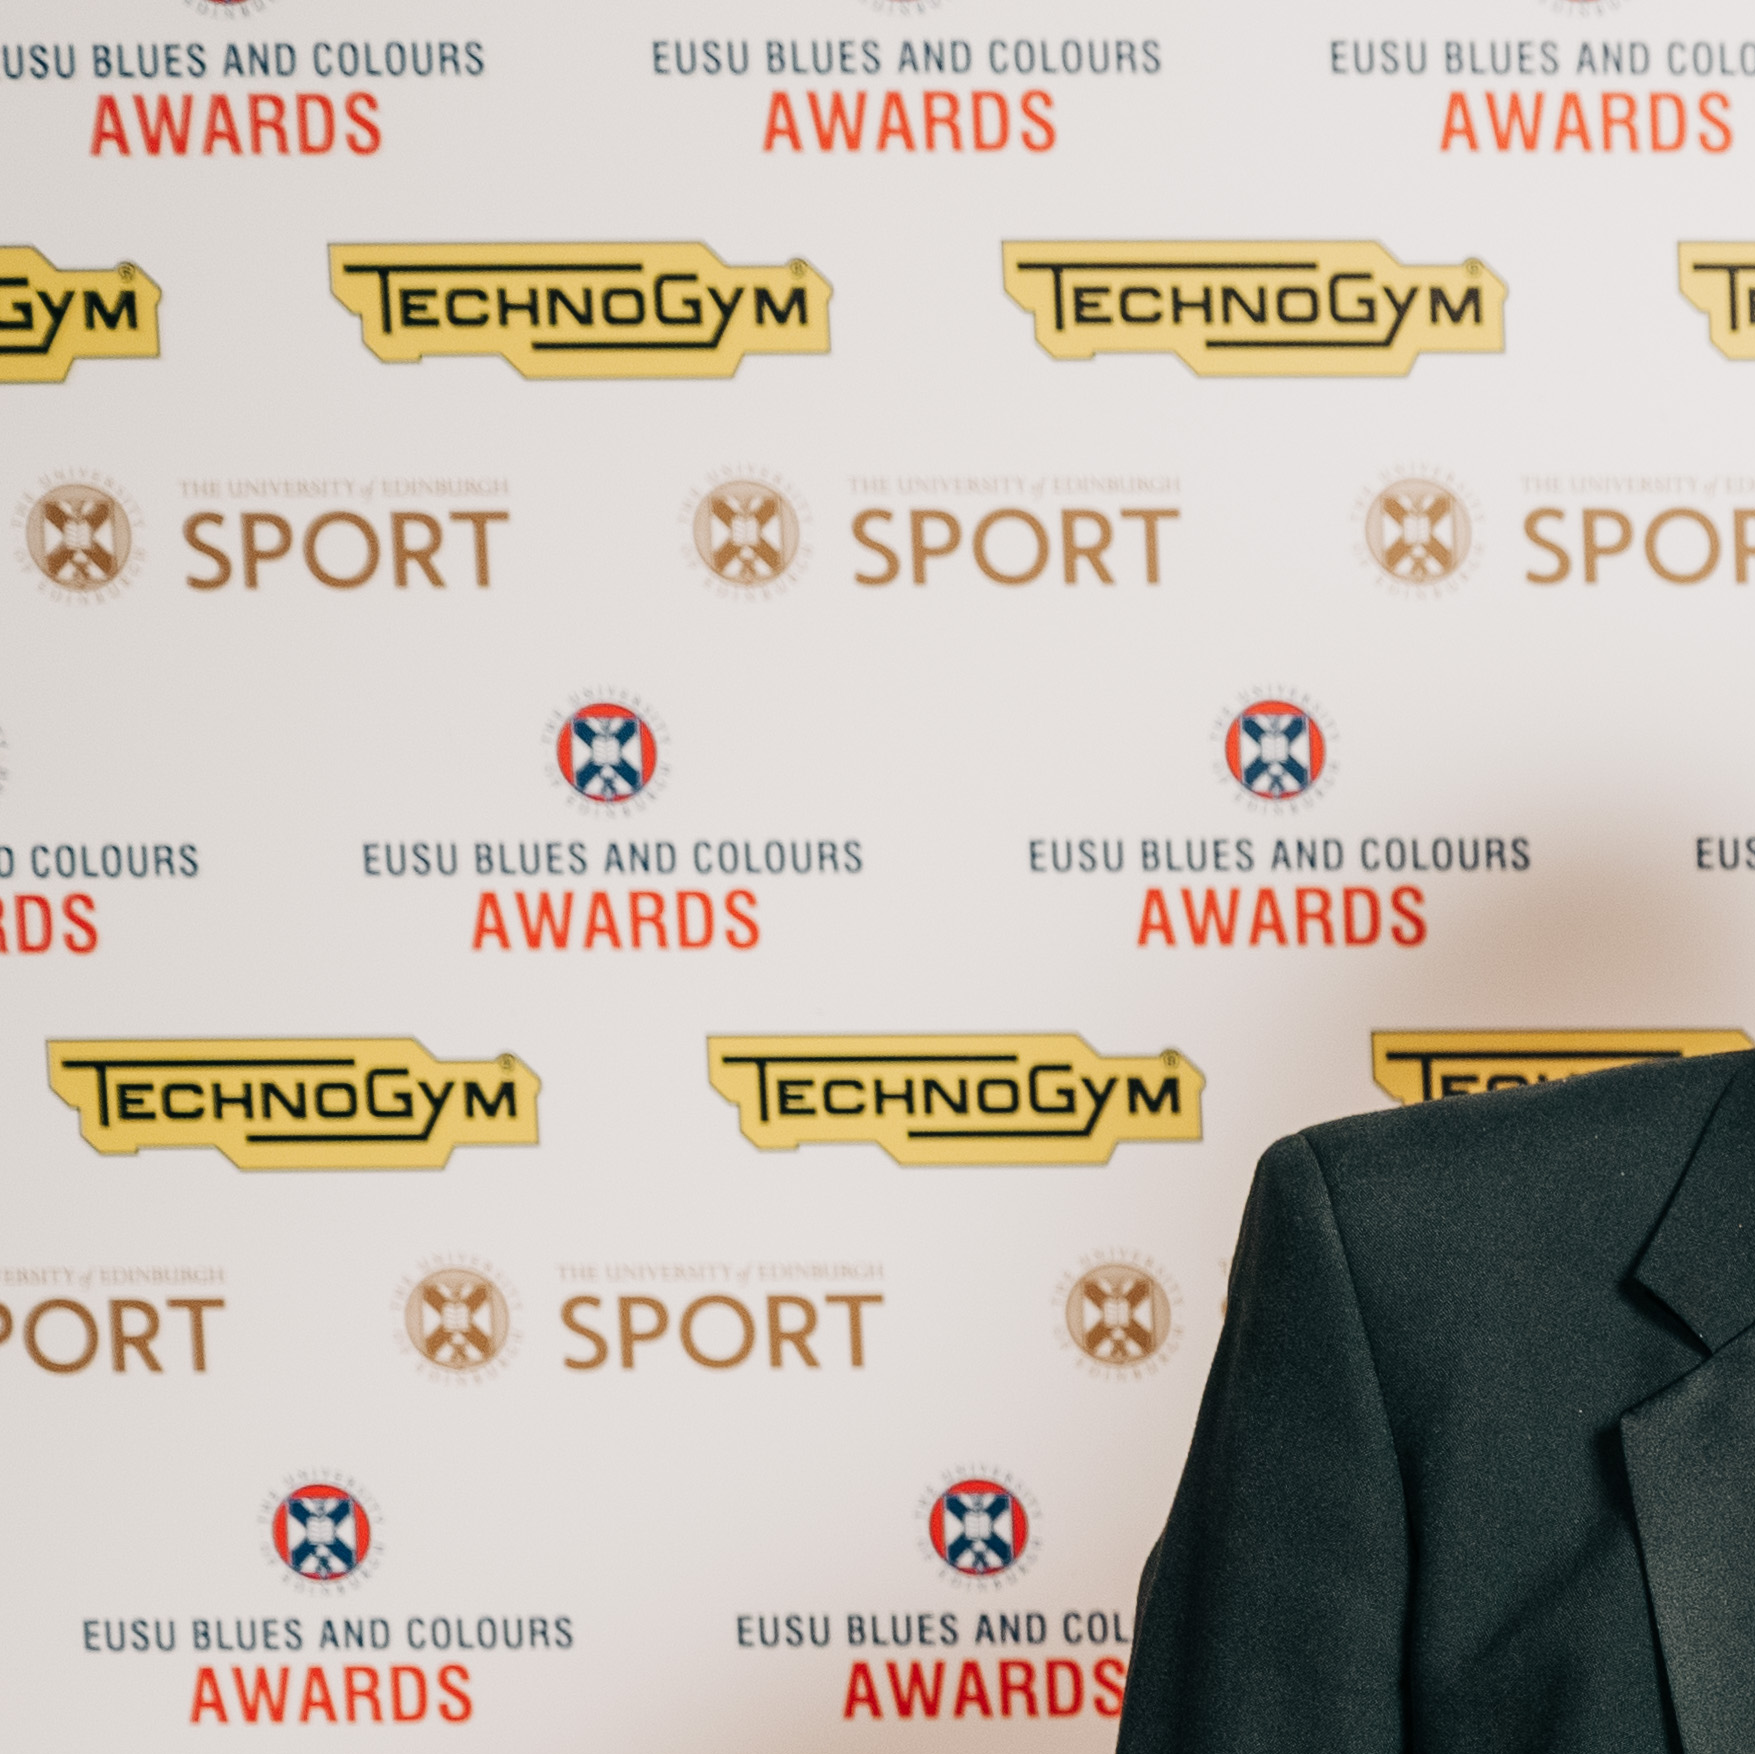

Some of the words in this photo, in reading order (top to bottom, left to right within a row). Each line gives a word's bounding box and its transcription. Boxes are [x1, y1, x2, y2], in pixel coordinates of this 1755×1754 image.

[651, 39, 750, 77] EUSU
[765, 39, 882, 76] BLUES
[897, 39, 973, 75] AND
[988, 39, 1162, 75] COLOURS
[91, 91, 382, 157] AWARDS
[763, 89, 1057, 153] AWARDS
[1440, 91, 1733, 154] AWARDS
[226, 479, 355, 499] UNIVERSITY
[896, 476, 1025, 495] UNIVERSITY
[1568, 475, 1698, 495] UNIVERSITY
[182, 510, 510, 592] SPORT
[851, 507, 1181, 588] SPORT
[362, 841, 459, 878] EUSU
[473, 841, 589, 877] BLUES
[603, 841, 677, 875] AND
[692, 839, 864, 875] COLOURS
[1028, 839, 1124, 873] EUSU
[1140, 838, 1255, 873] BLUES
[1270, 837, 1345, 872] AND
[1359, 835, 1532, 874] COLOURS
[472, 888, 760, 950] AWARDS
[1137, 884, 1427, 948] AWARDS
[604, 1263, 731, 1282] UNIVERSITY
[560, 1293, 885, 1372] SPORT
[82, 1617, 177, 1653] EUSU
[191, 1617, 304, 1652] BLUES
[319, 1617, 391, 1651] AND
[406, 1615, 574, 1651] COLOURS
[190, 1663, 473, 1724] AWARDS
[843, 1656, 1127, 1720] AWARDS
